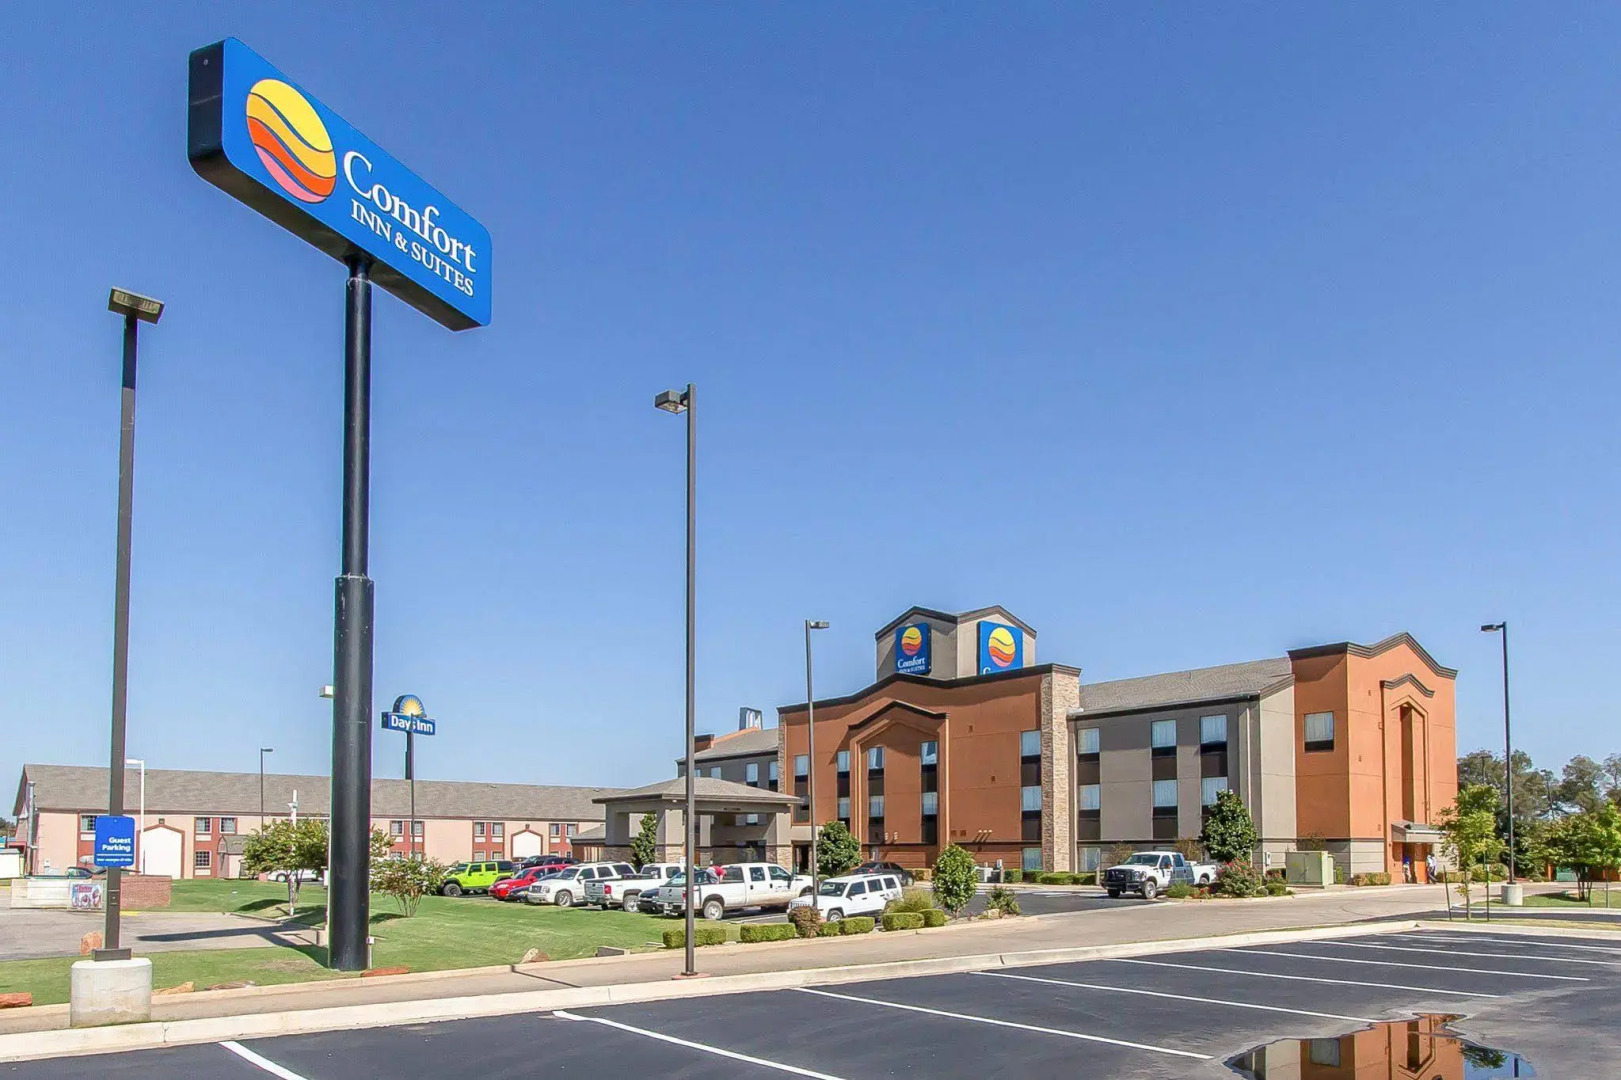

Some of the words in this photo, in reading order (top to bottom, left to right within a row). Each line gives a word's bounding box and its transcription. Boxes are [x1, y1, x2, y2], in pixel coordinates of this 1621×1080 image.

[343, 151, 477, 272] Comfort
[351, 198, 392, 242] INN
[394, 231, 408, 253] &
[411, 241, 474, 297] SUITES
[897, 656, 925, 668] Comfort
[417, 719, 433, 732] Inn
[102, 844, 131, 852] Parking
